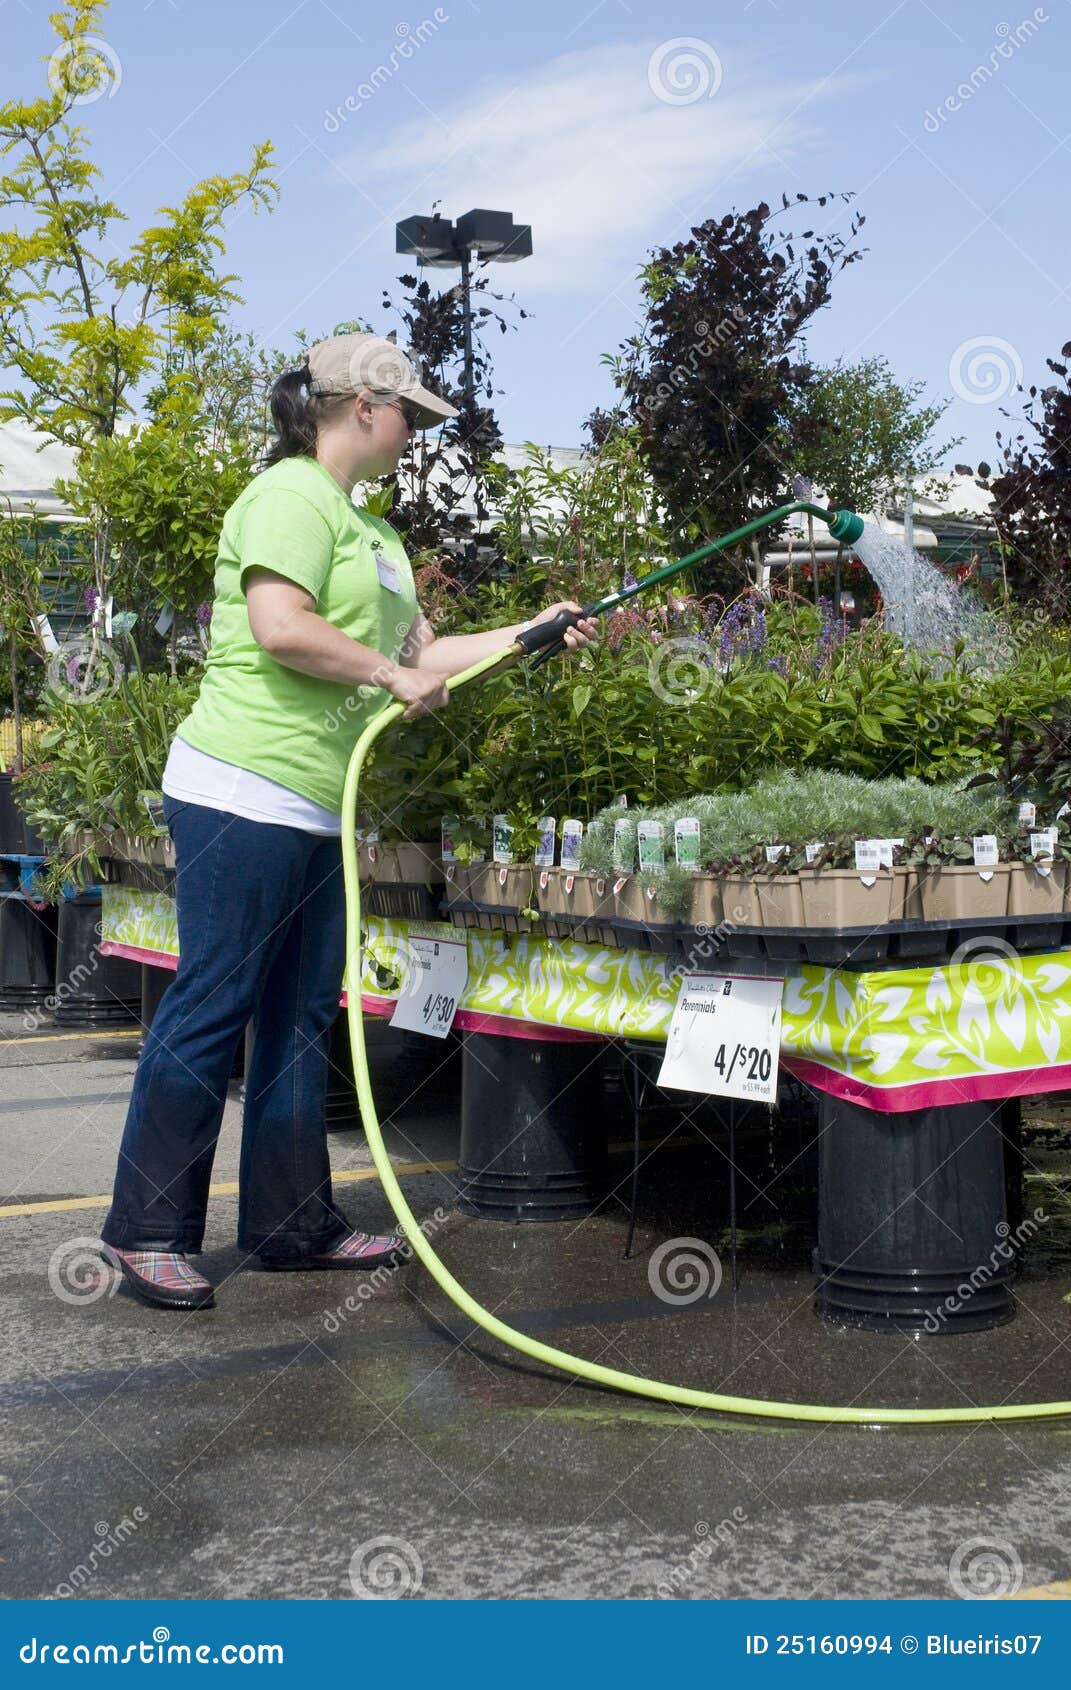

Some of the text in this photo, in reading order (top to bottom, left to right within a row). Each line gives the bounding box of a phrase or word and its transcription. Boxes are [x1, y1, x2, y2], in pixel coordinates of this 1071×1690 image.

[422, 993, 455, 1024] 4/$30
[680, 998, 716, 1014] Perennials
[713, 1043, 772, 1083] 4/$20
